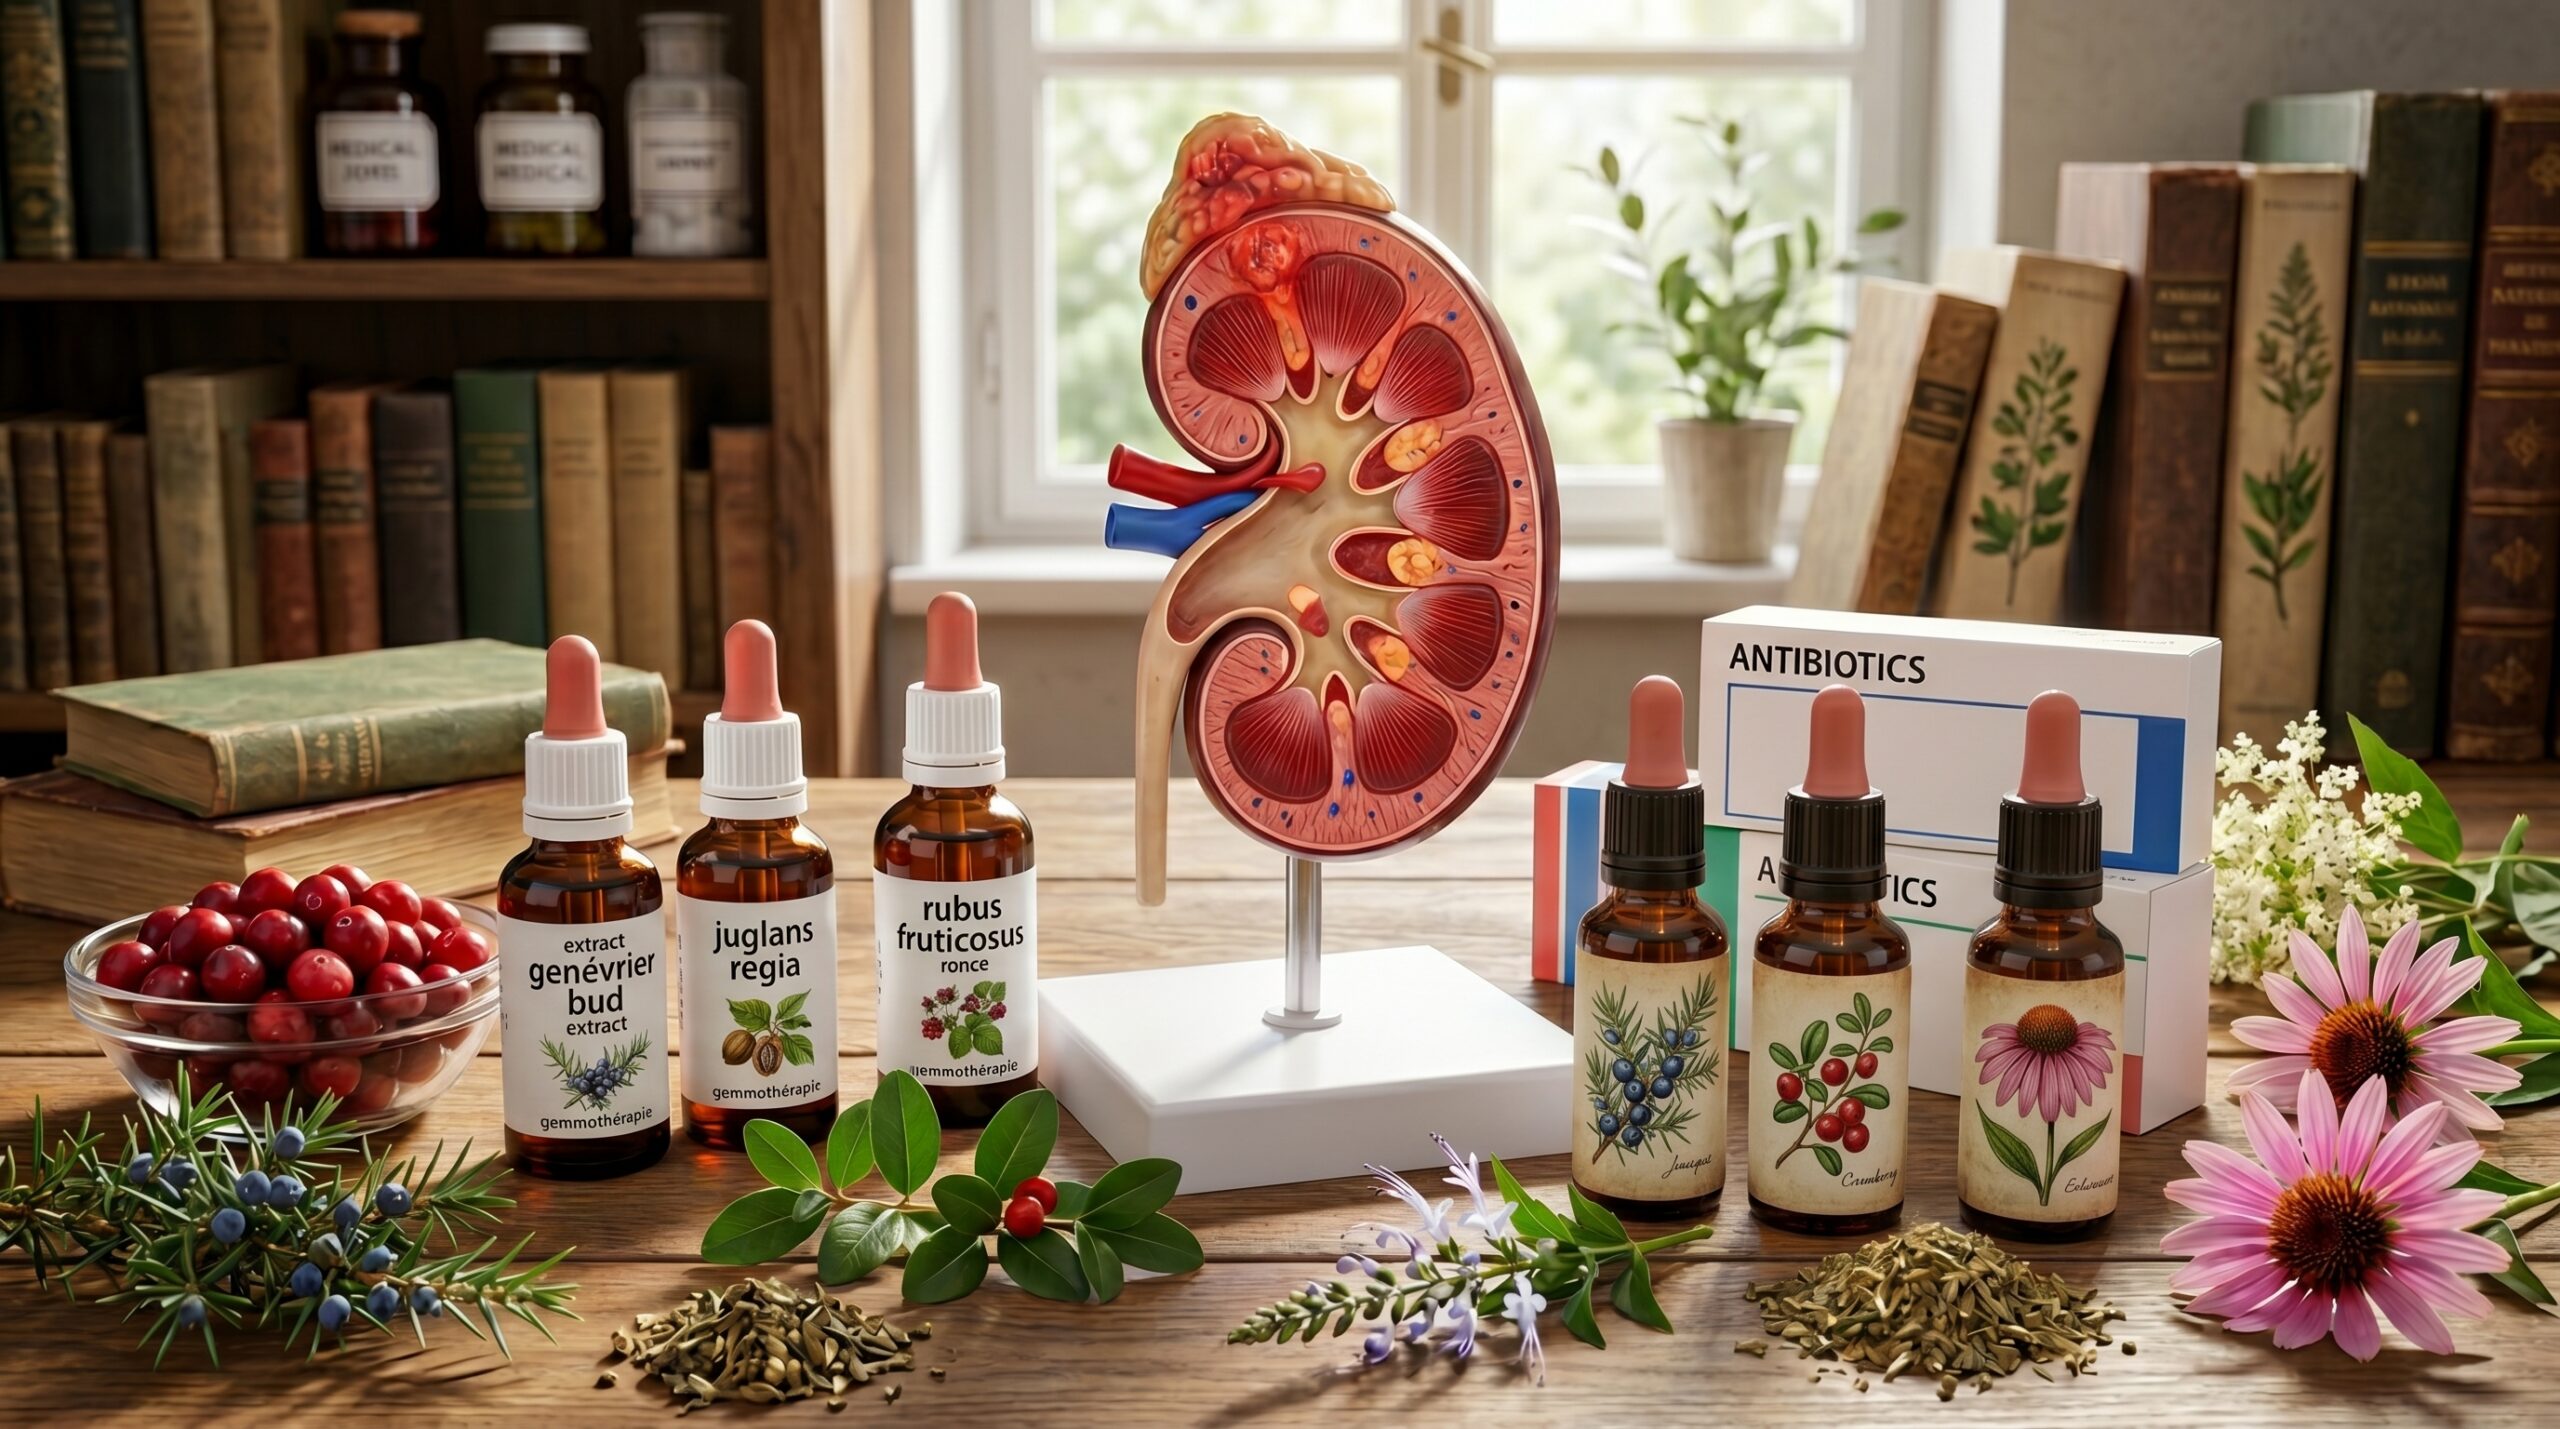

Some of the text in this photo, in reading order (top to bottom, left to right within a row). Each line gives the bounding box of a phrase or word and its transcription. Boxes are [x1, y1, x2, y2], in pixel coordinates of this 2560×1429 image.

[1728, 642, 1926, 684] ANTIBIOTICS
[923, 894, 1002, 922] rubus
[563, 933, 626, 954] extract
[712, 919, 814, 957] juglans
[896, 922, 1024, 953] fruticosus
[528, 951, 655, 991] genévrier
[730, 952, 801, 987] regia
[940, 957, 990, 974] ronce
[568, 984, 624, 1016] bud
[566, 1016, 628, 1036] extract
[540, 1106, 653, 1132] gemmothérapie
